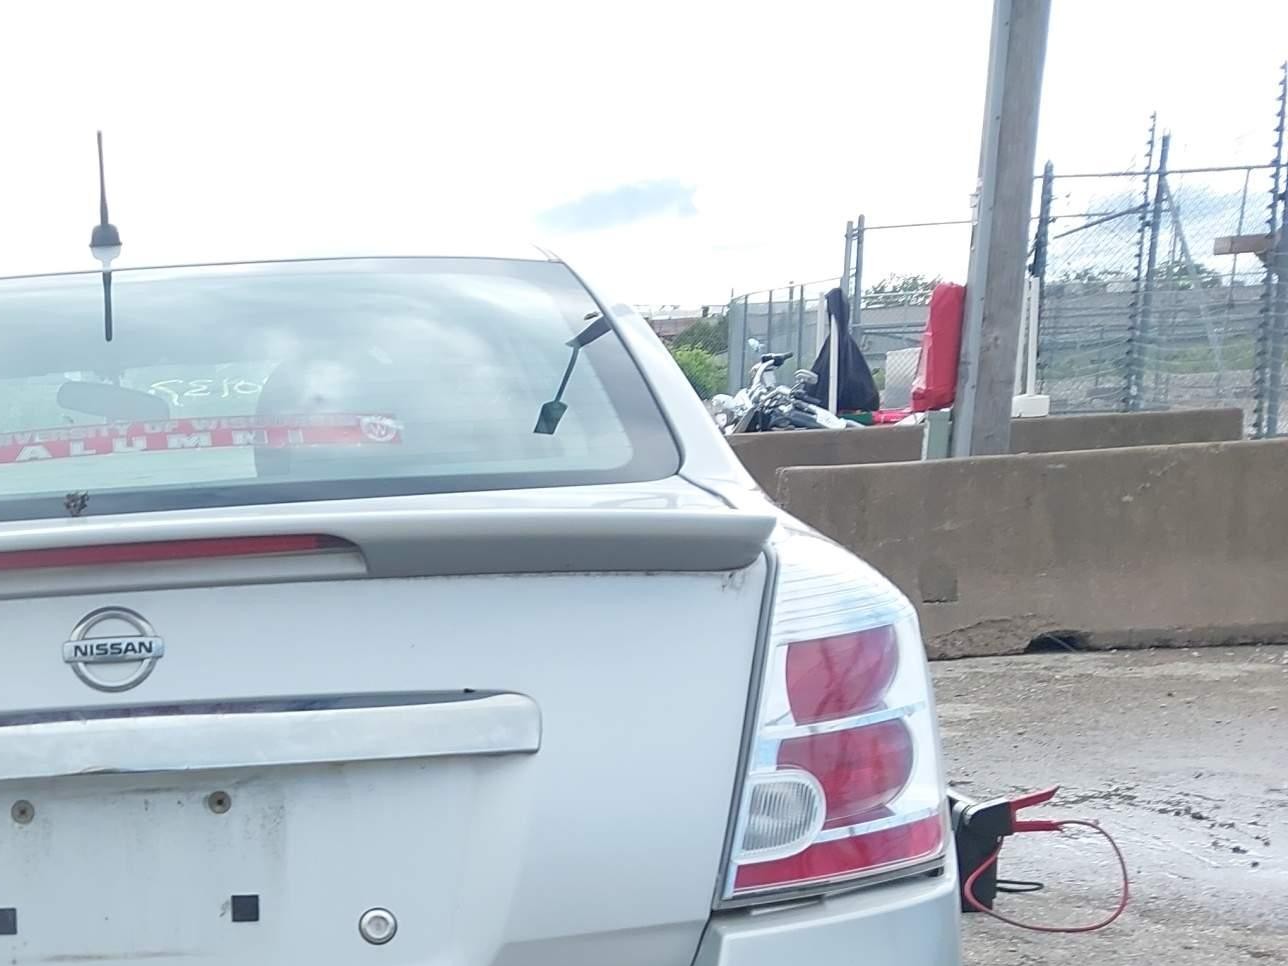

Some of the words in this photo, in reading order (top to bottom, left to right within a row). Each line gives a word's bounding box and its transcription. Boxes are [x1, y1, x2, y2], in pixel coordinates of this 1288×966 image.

[144, 419, 180, 433] OF
[16, 429, 304, 461] ALUMNI
[74, 640, 152, 657] NISSAN
